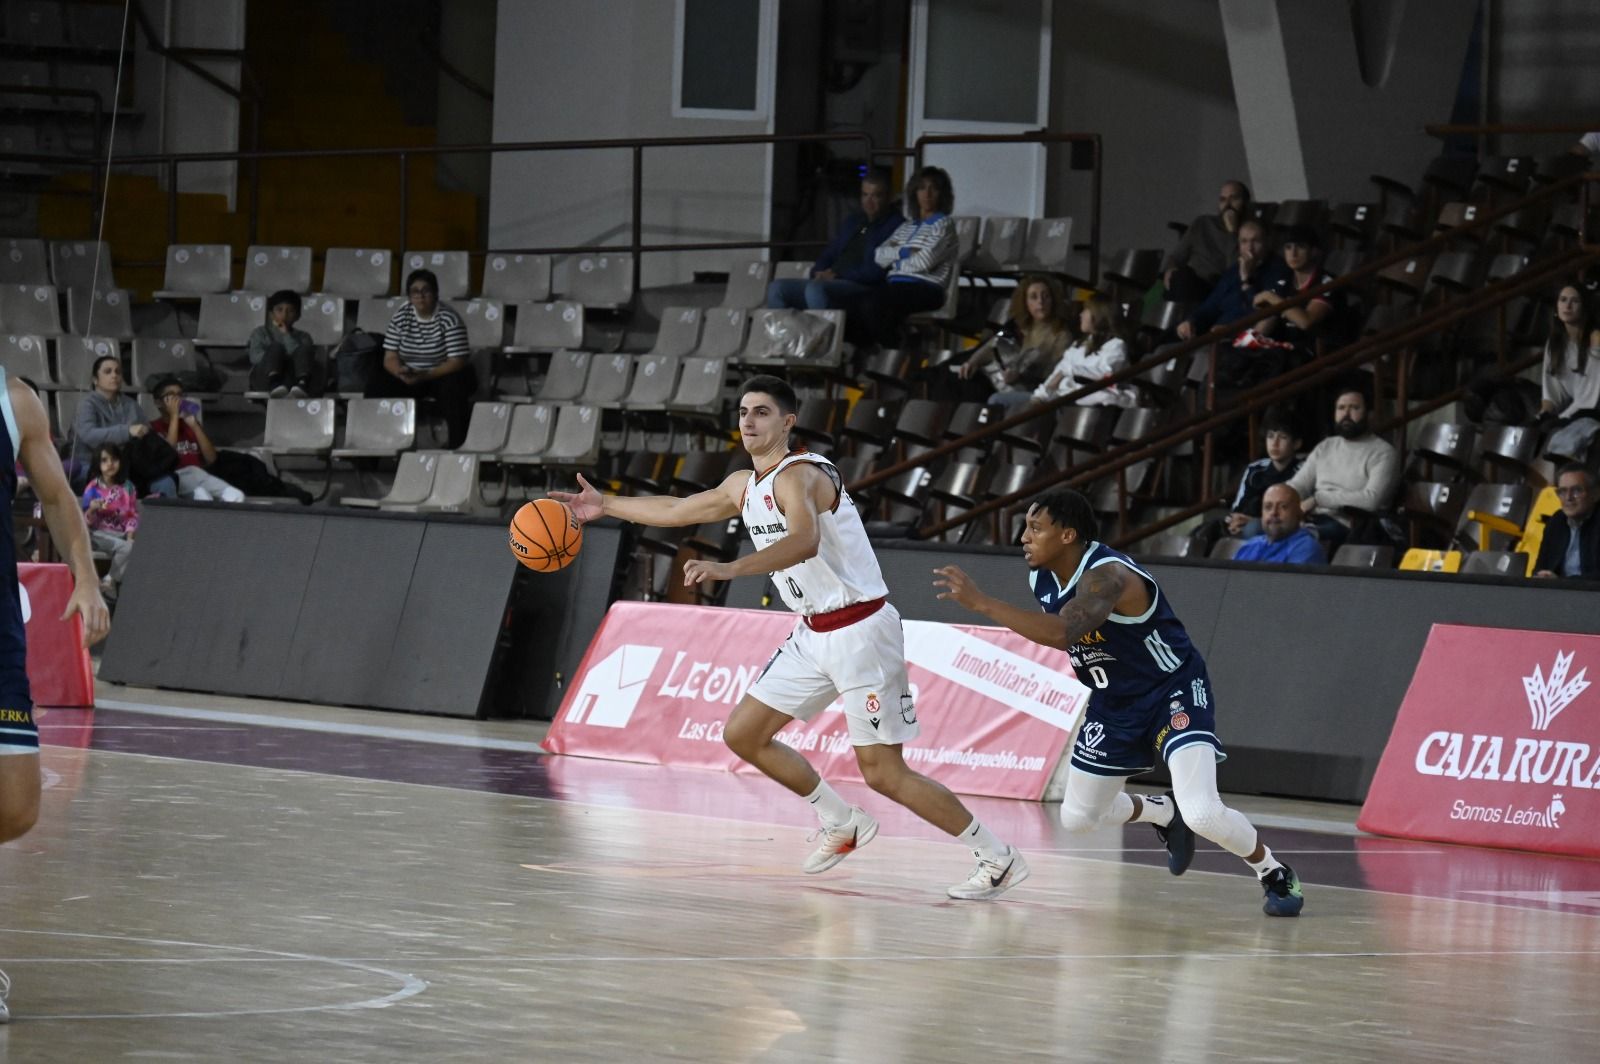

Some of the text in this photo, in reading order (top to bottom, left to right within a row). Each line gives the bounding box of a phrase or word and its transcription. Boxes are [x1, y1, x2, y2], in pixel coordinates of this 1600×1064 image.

[951, 646, 1082, 715] Inmobiliaria Rural
[1089, 666, 1109, 689] 0
[677, 717, 707, 740] Las
[1415, 731, 1504, 781] CAJA
[1450, 799, 1541, 827] Somos León
